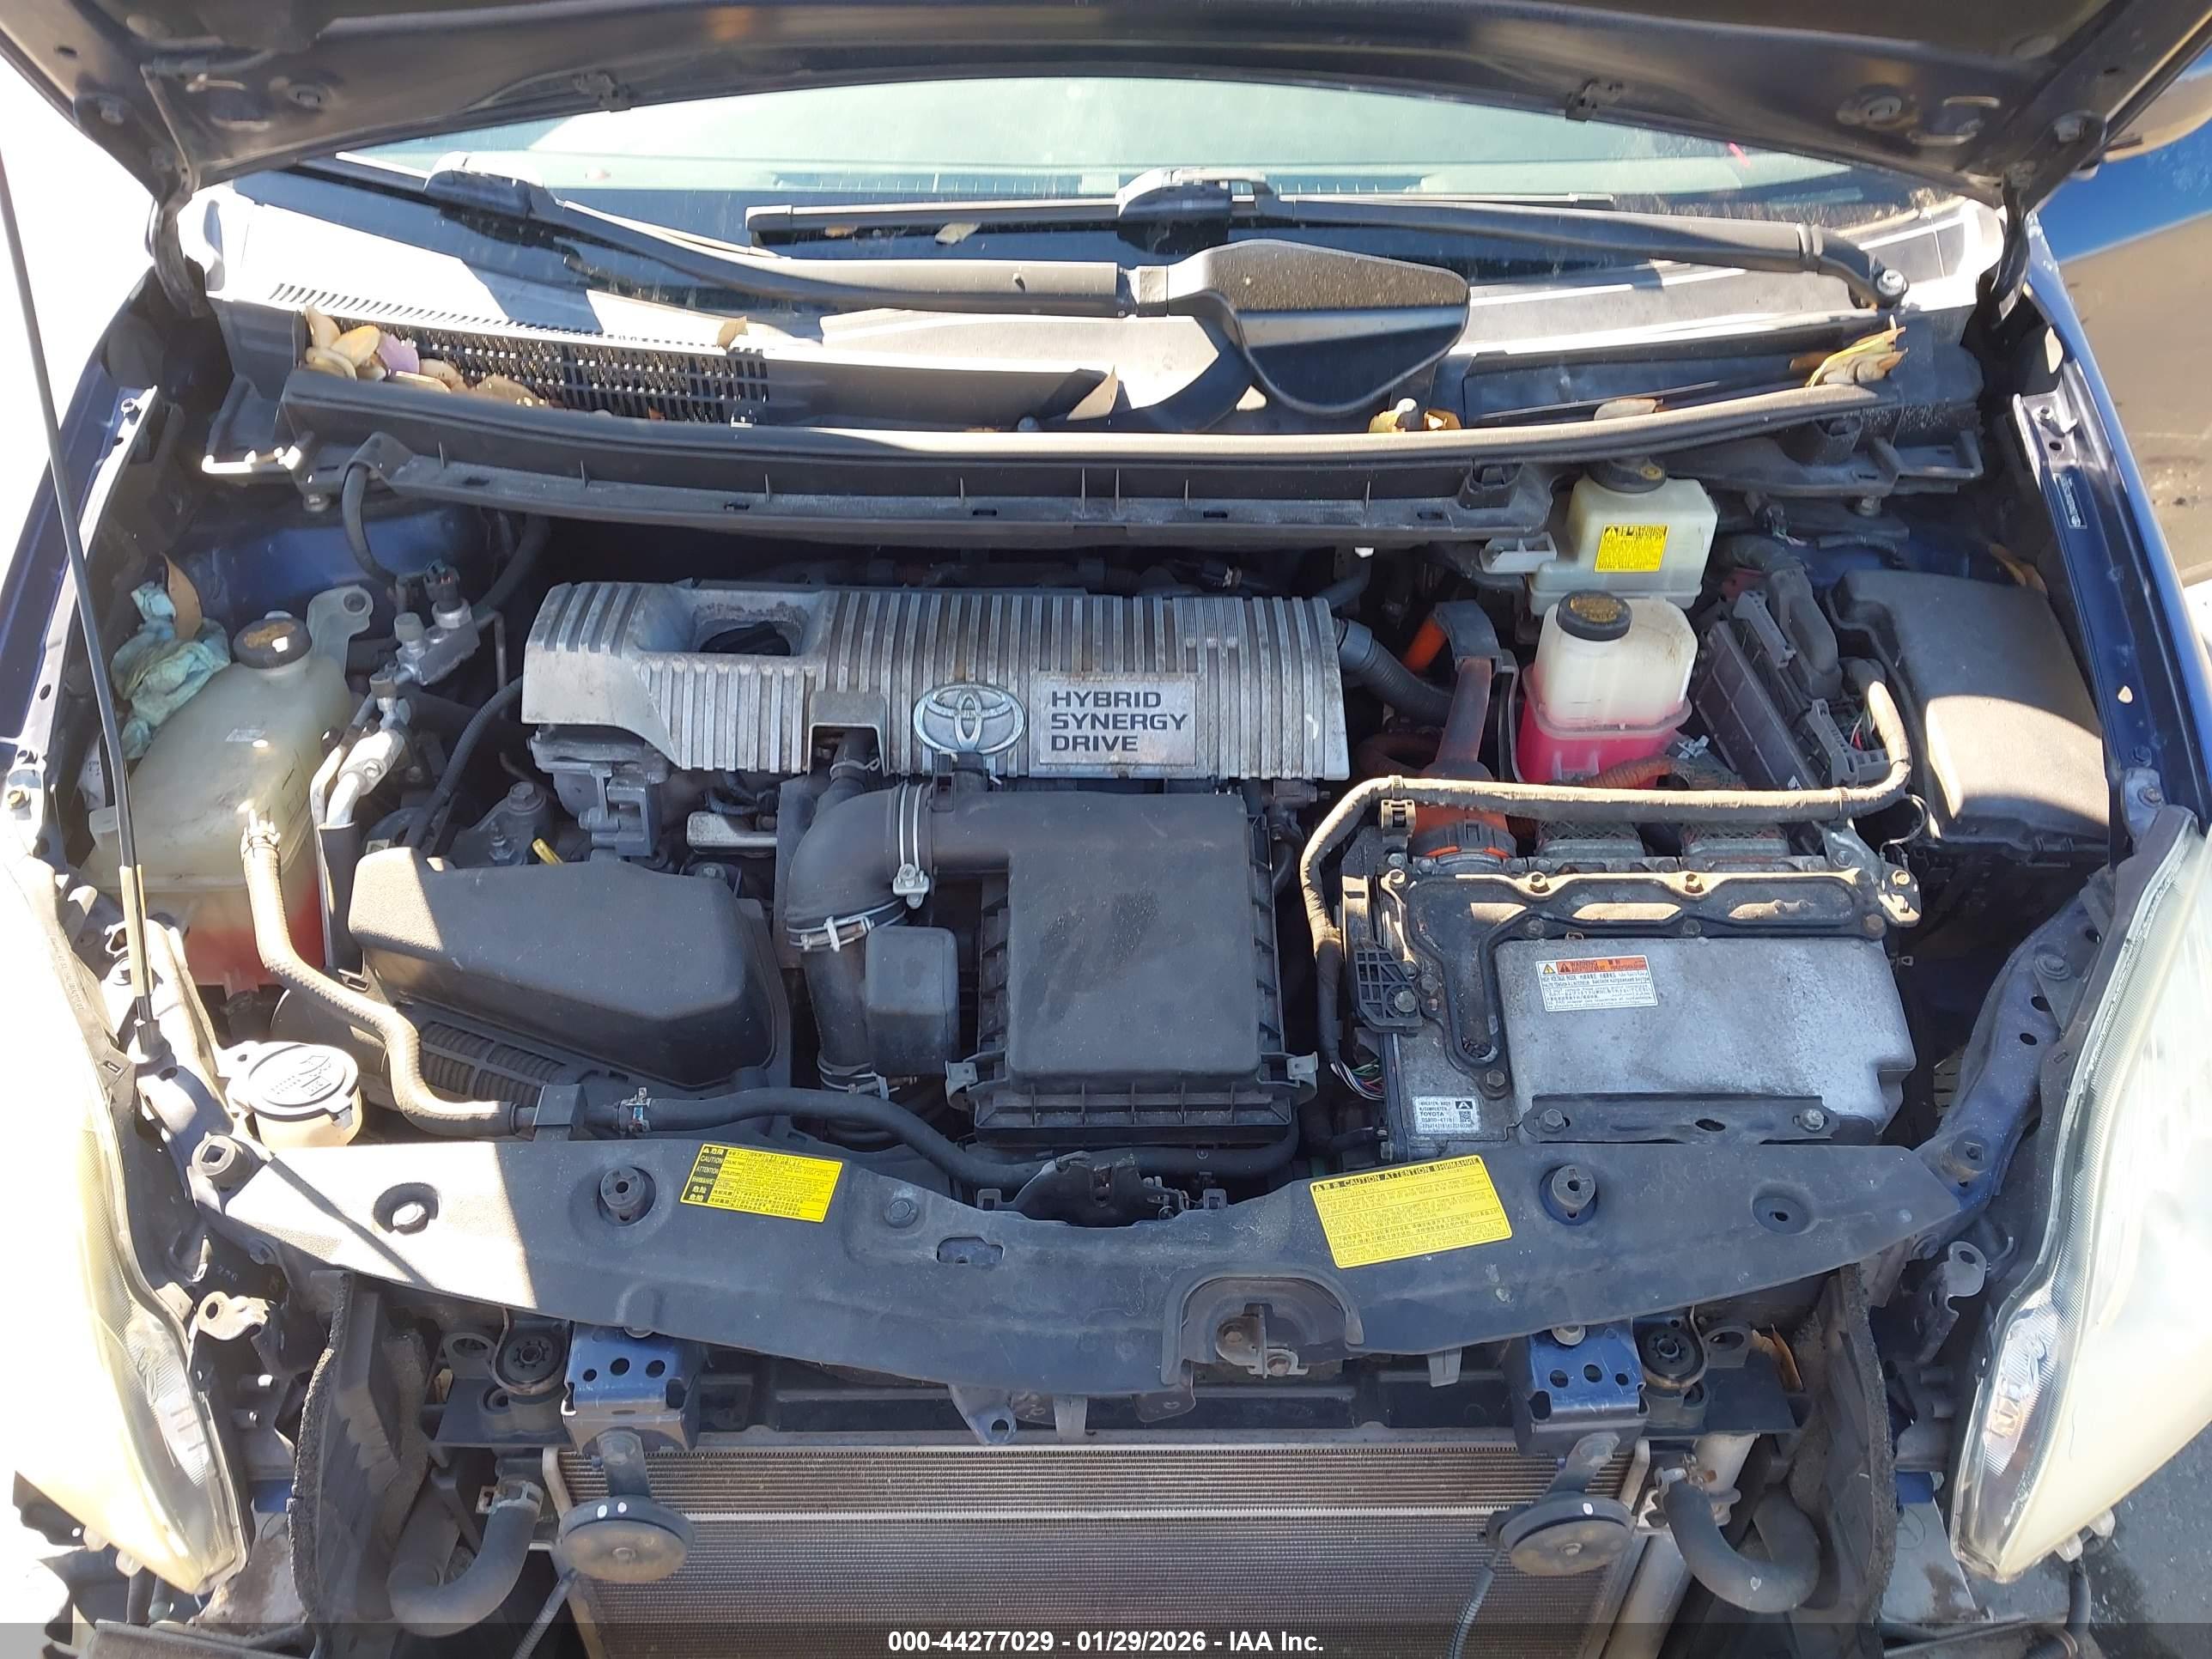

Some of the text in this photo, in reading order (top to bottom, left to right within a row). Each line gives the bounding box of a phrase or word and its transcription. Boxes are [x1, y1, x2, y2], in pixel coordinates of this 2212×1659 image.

[1051, 691, 1161, 708] HYBRID
[1050, 714, 1188, 731] SYNERGY
[1050, 735, 1139, 752] DRIVE
[700, 1155, 723, 1164] CAUTION
[696, 1164, 720, 1176] ATTENTION
[1344, 1174, 1381, 1187] CAUTION
[1384, 1165, 1431, 1181] ATTENTION
[1433, 1158, 1476, 1171] ВНИМАНИЕ
